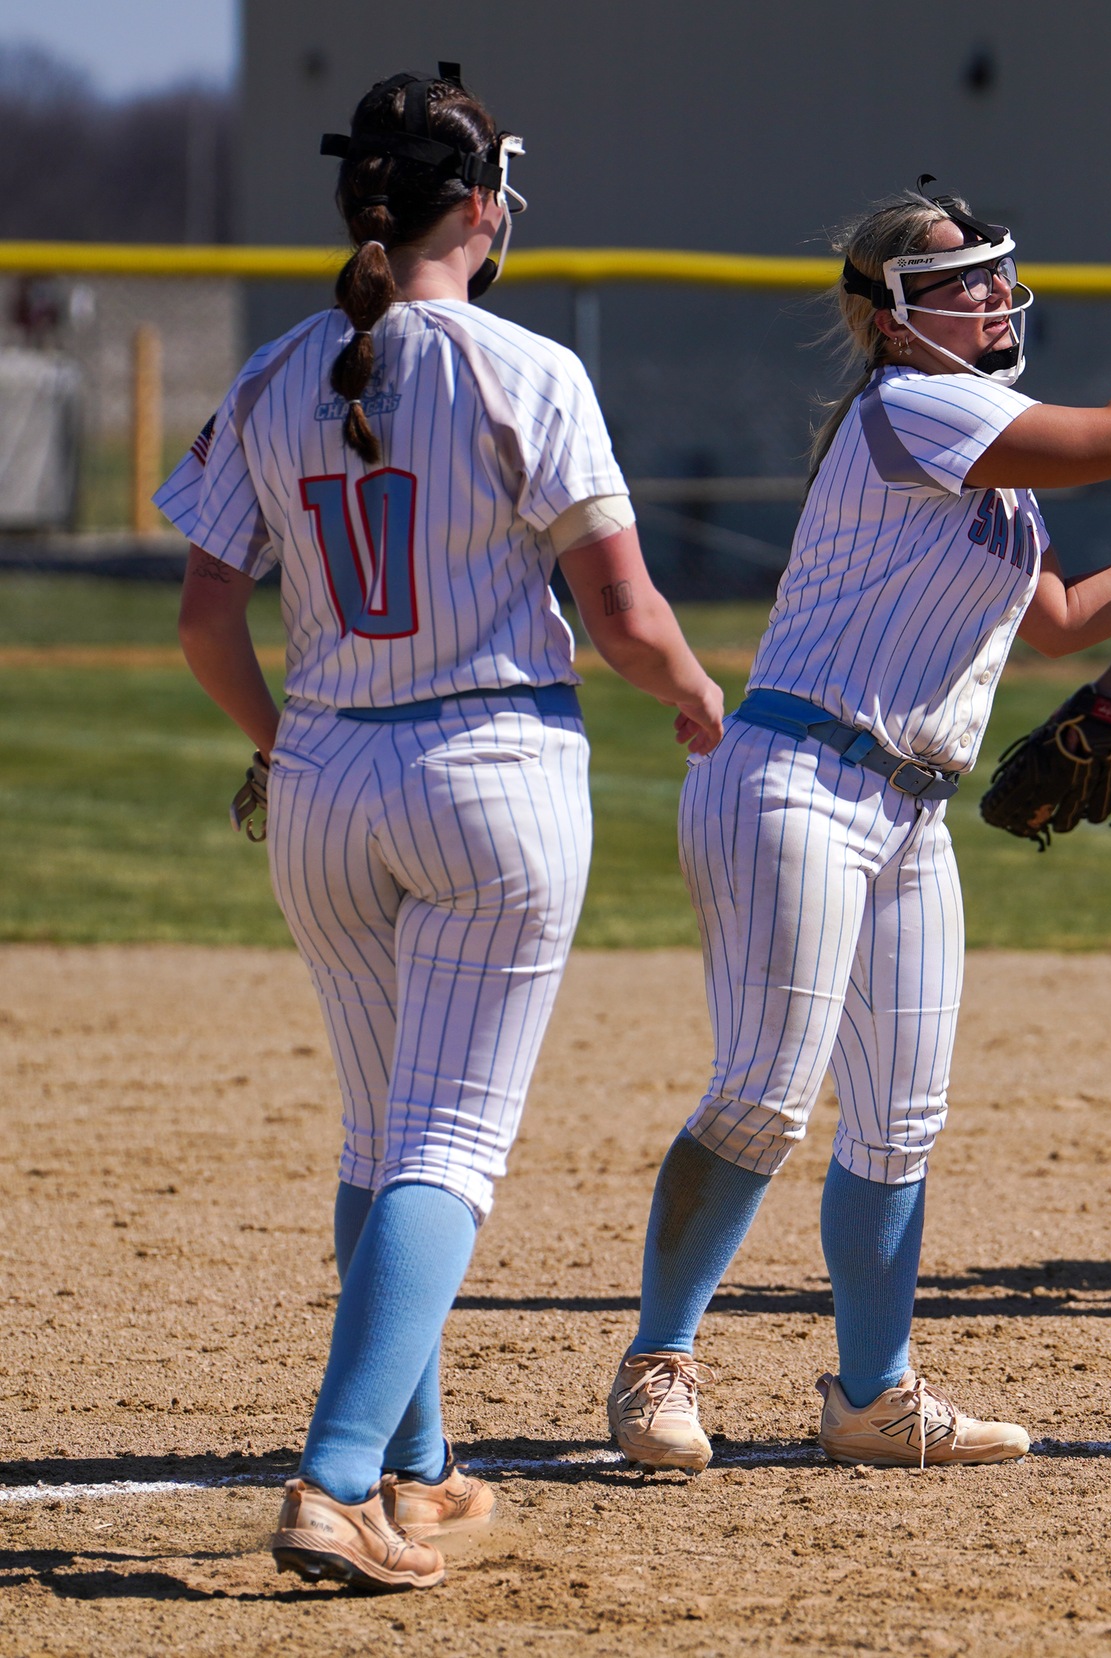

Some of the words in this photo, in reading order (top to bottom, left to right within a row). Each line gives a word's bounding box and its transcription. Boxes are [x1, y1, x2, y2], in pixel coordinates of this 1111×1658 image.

[907, 257, 935, 266] RIP-IT
[298, 467, 419, 639] 10
[600, 579, 635, 616] 10
